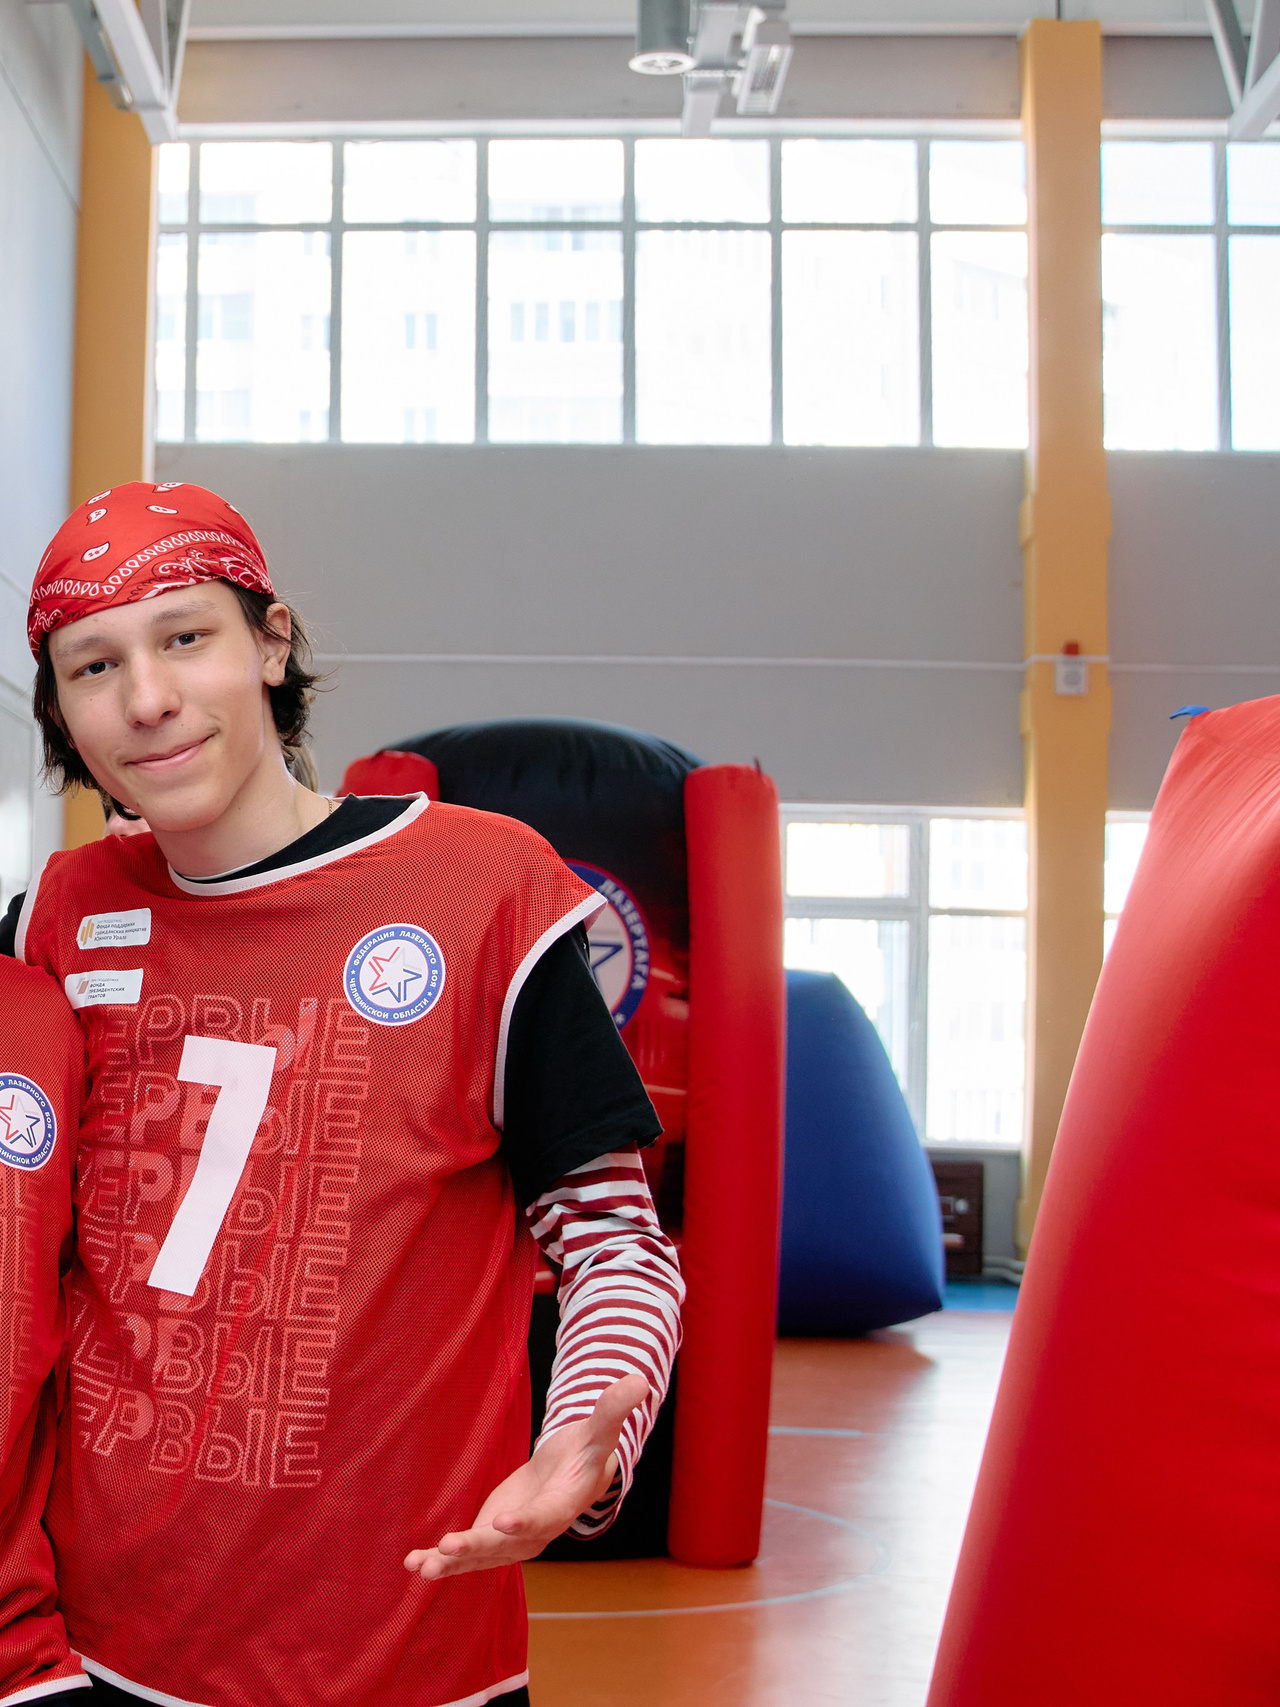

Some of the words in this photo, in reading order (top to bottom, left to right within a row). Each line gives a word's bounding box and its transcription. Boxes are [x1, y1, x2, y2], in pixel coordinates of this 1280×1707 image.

[353, 930, 395, 966] ФЕДЕРАЦИЯ
[399, 930, 437, 964] ЛАЗЕРНОГО
[430, 969, 438, 988] БОЯ
[349, 977, 389, 1019] ЧЕЛЯБИНСКОЙ
[393, 998, 429, 1020] ОБЛАСТИ
[8, 1079, 46, 1107] ЛАЗЕРНОГО
[31, 1140, 52, 1164] ОБЛАСТИ
[147, 1034, 278, 1297] 7
